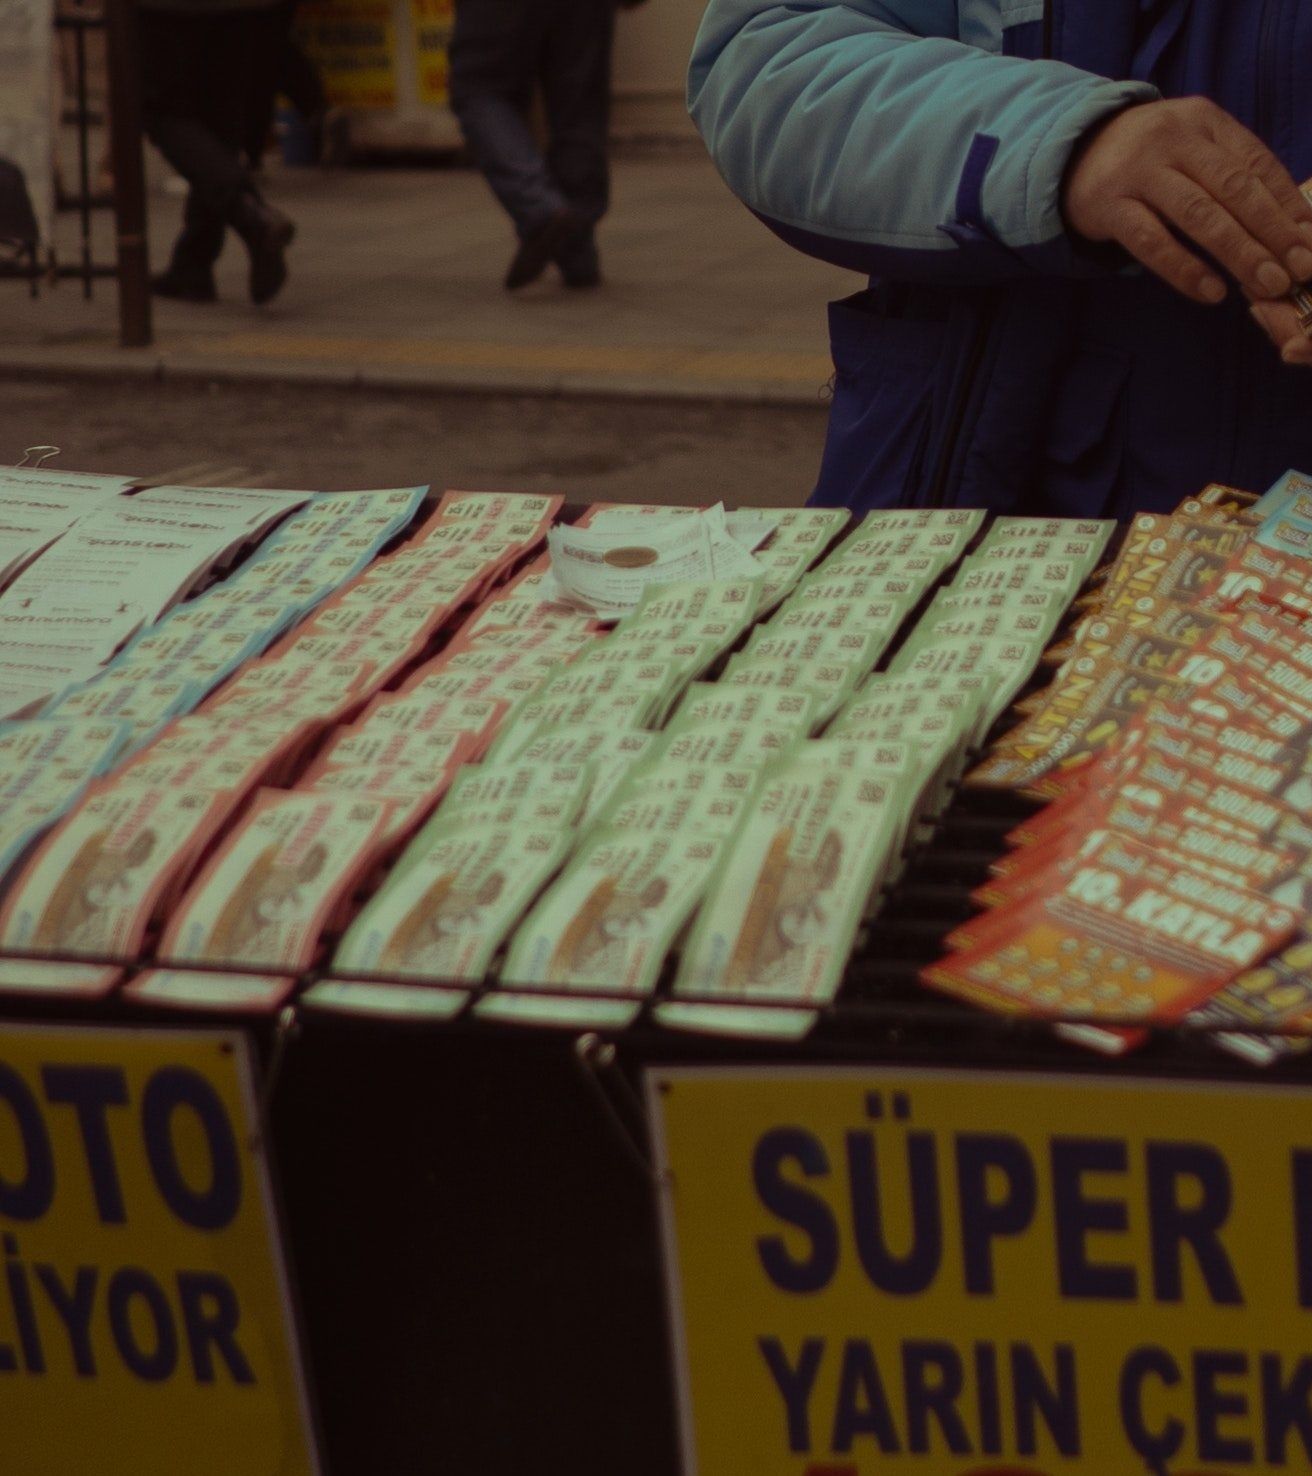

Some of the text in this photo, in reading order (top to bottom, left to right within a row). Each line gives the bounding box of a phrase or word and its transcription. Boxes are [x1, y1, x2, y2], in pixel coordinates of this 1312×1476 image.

[1123, 889, 1264, 967] KATLA
[751, 1091, 1243, 1306] SÜPER
[756, 1336, 1082, 1458] YARIN
